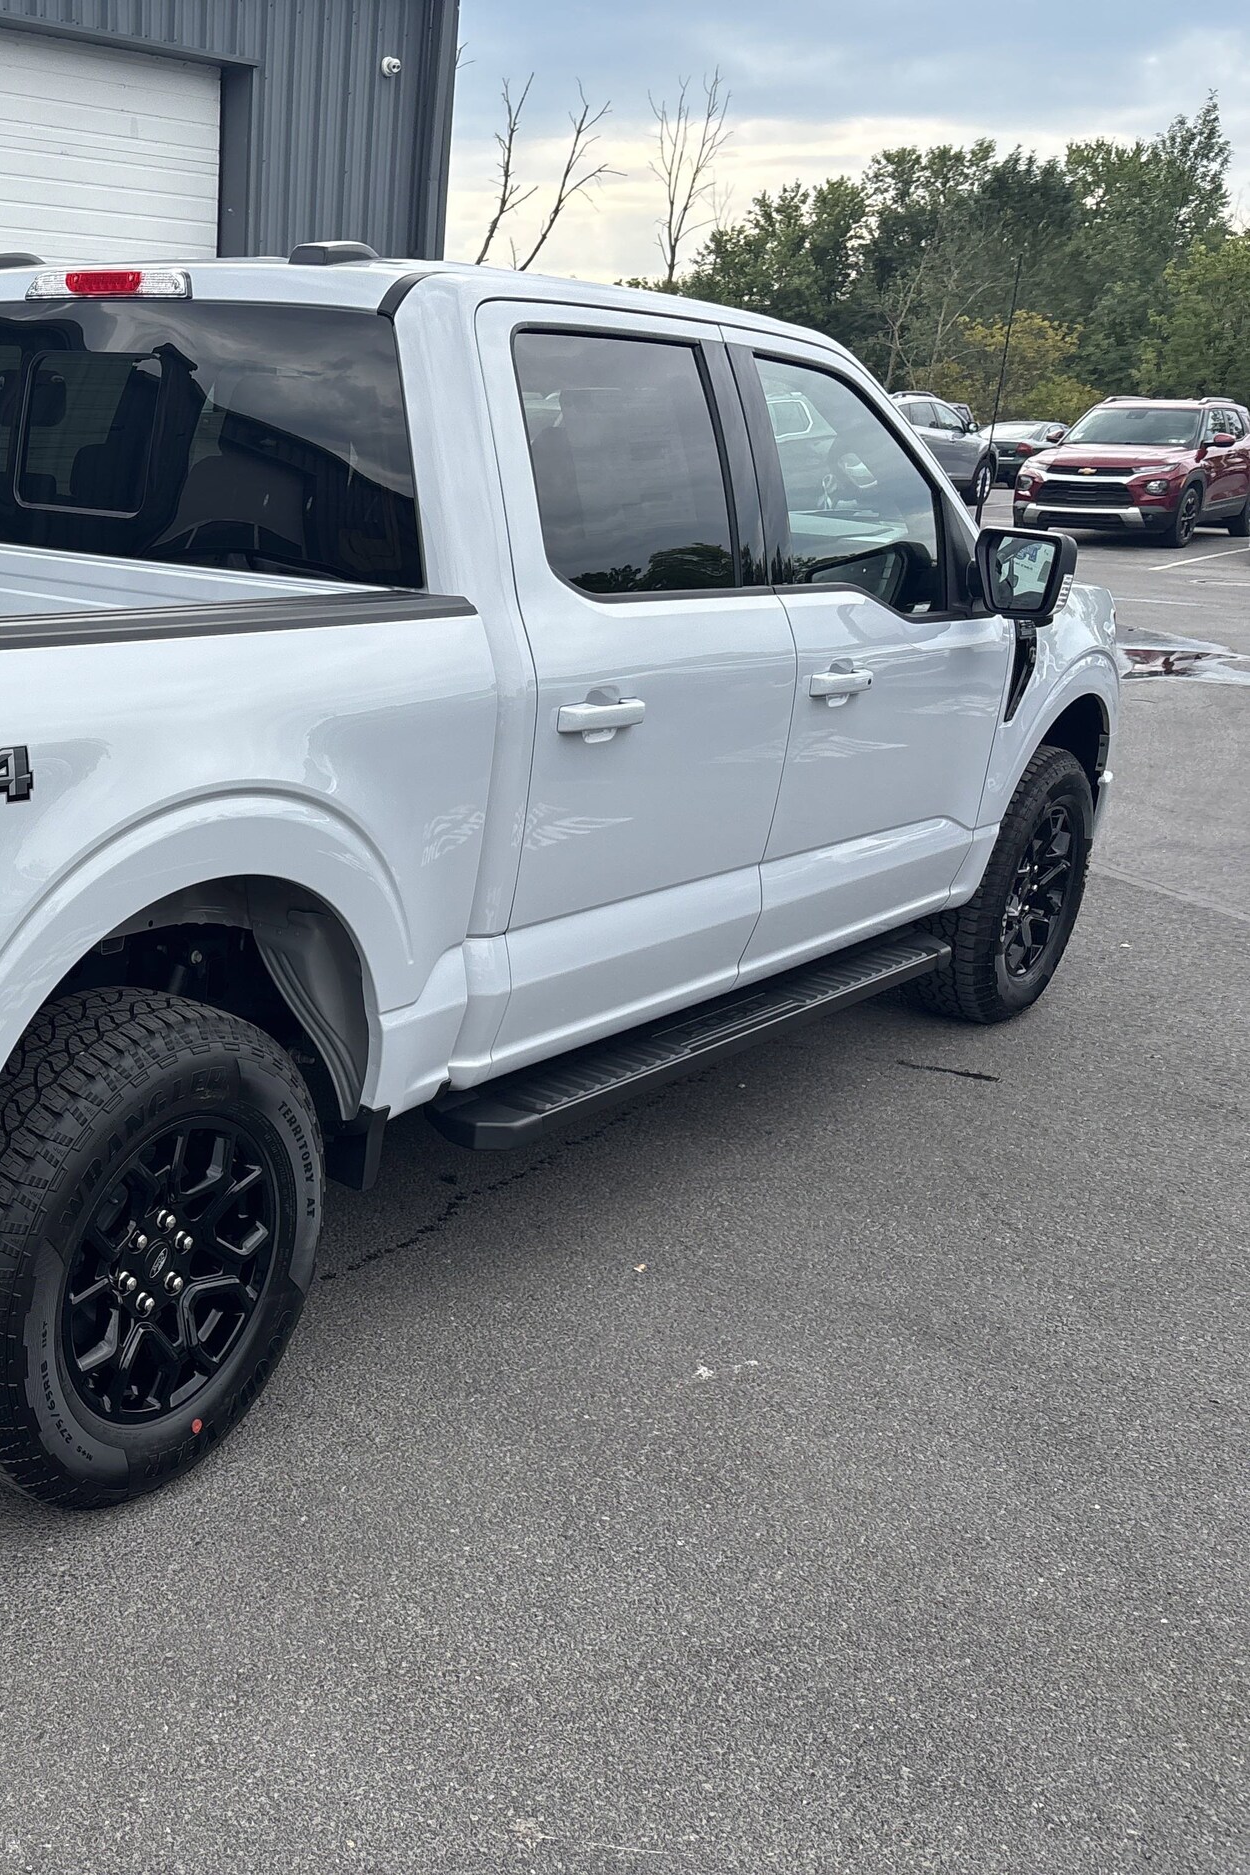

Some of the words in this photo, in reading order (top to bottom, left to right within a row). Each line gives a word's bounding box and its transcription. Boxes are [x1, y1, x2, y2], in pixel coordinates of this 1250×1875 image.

[277, 1100, 314, 1184] TERRITORY
[306, 1197, 316, 1219] AT
[40, 1360, 73, 1445] 275/65R18
